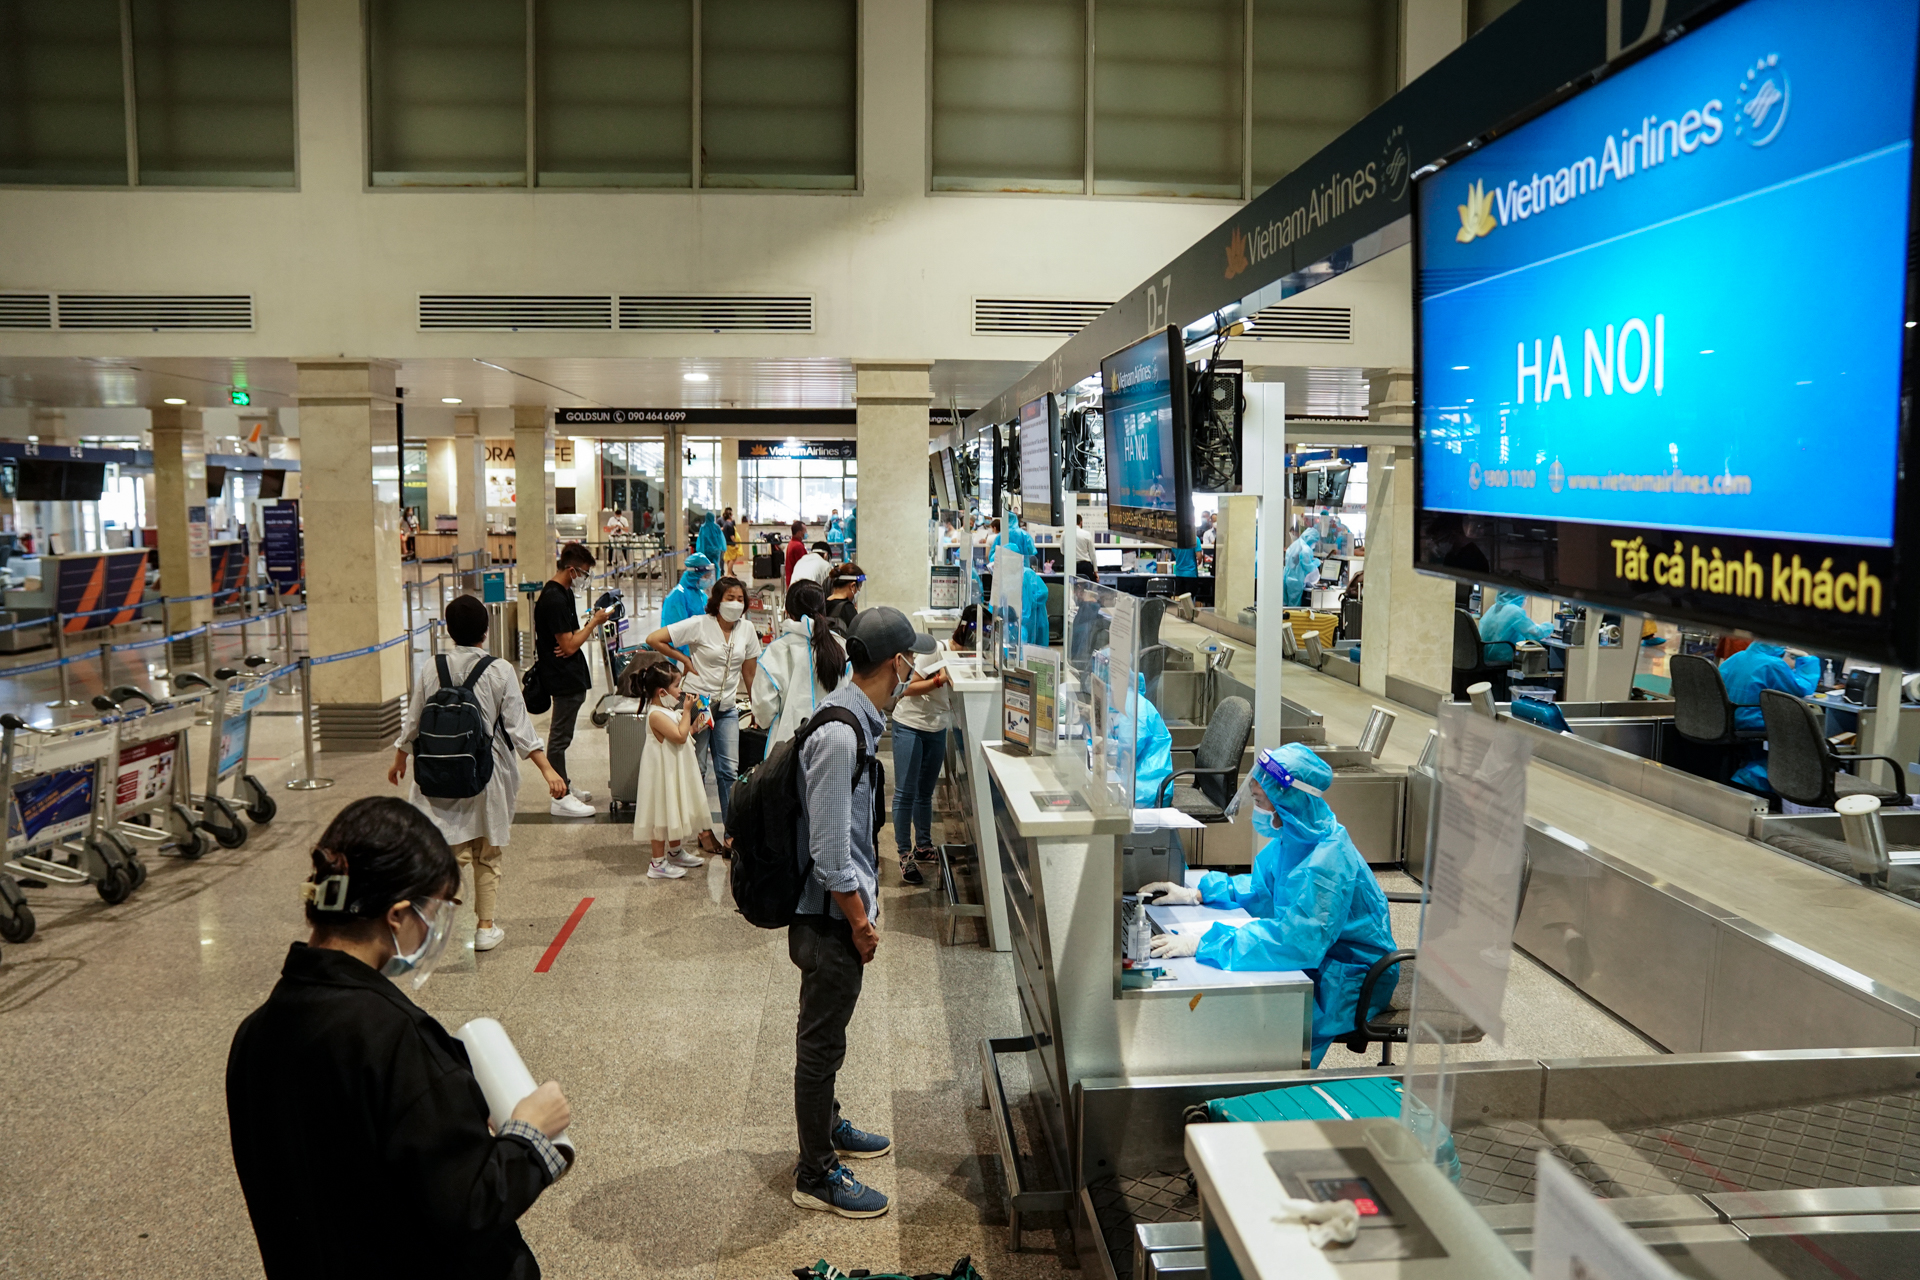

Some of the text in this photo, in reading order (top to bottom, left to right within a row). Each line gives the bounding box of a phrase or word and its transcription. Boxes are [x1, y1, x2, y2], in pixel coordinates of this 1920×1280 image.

[1147, 274, 1171, 334] D-7
[1051, 354, 1063, 391] D-6
[1516, 314, 1665, 405] HA NOI
[565, 411, 686, 421] GOLDSUN 090 464 6699
[1124, 432, 1148, 462] HA NOI
[1568, 470, 1752, 496] www.vietnamairlines.com
[1611, 536, 1883, 617] Tất cả hành khách
